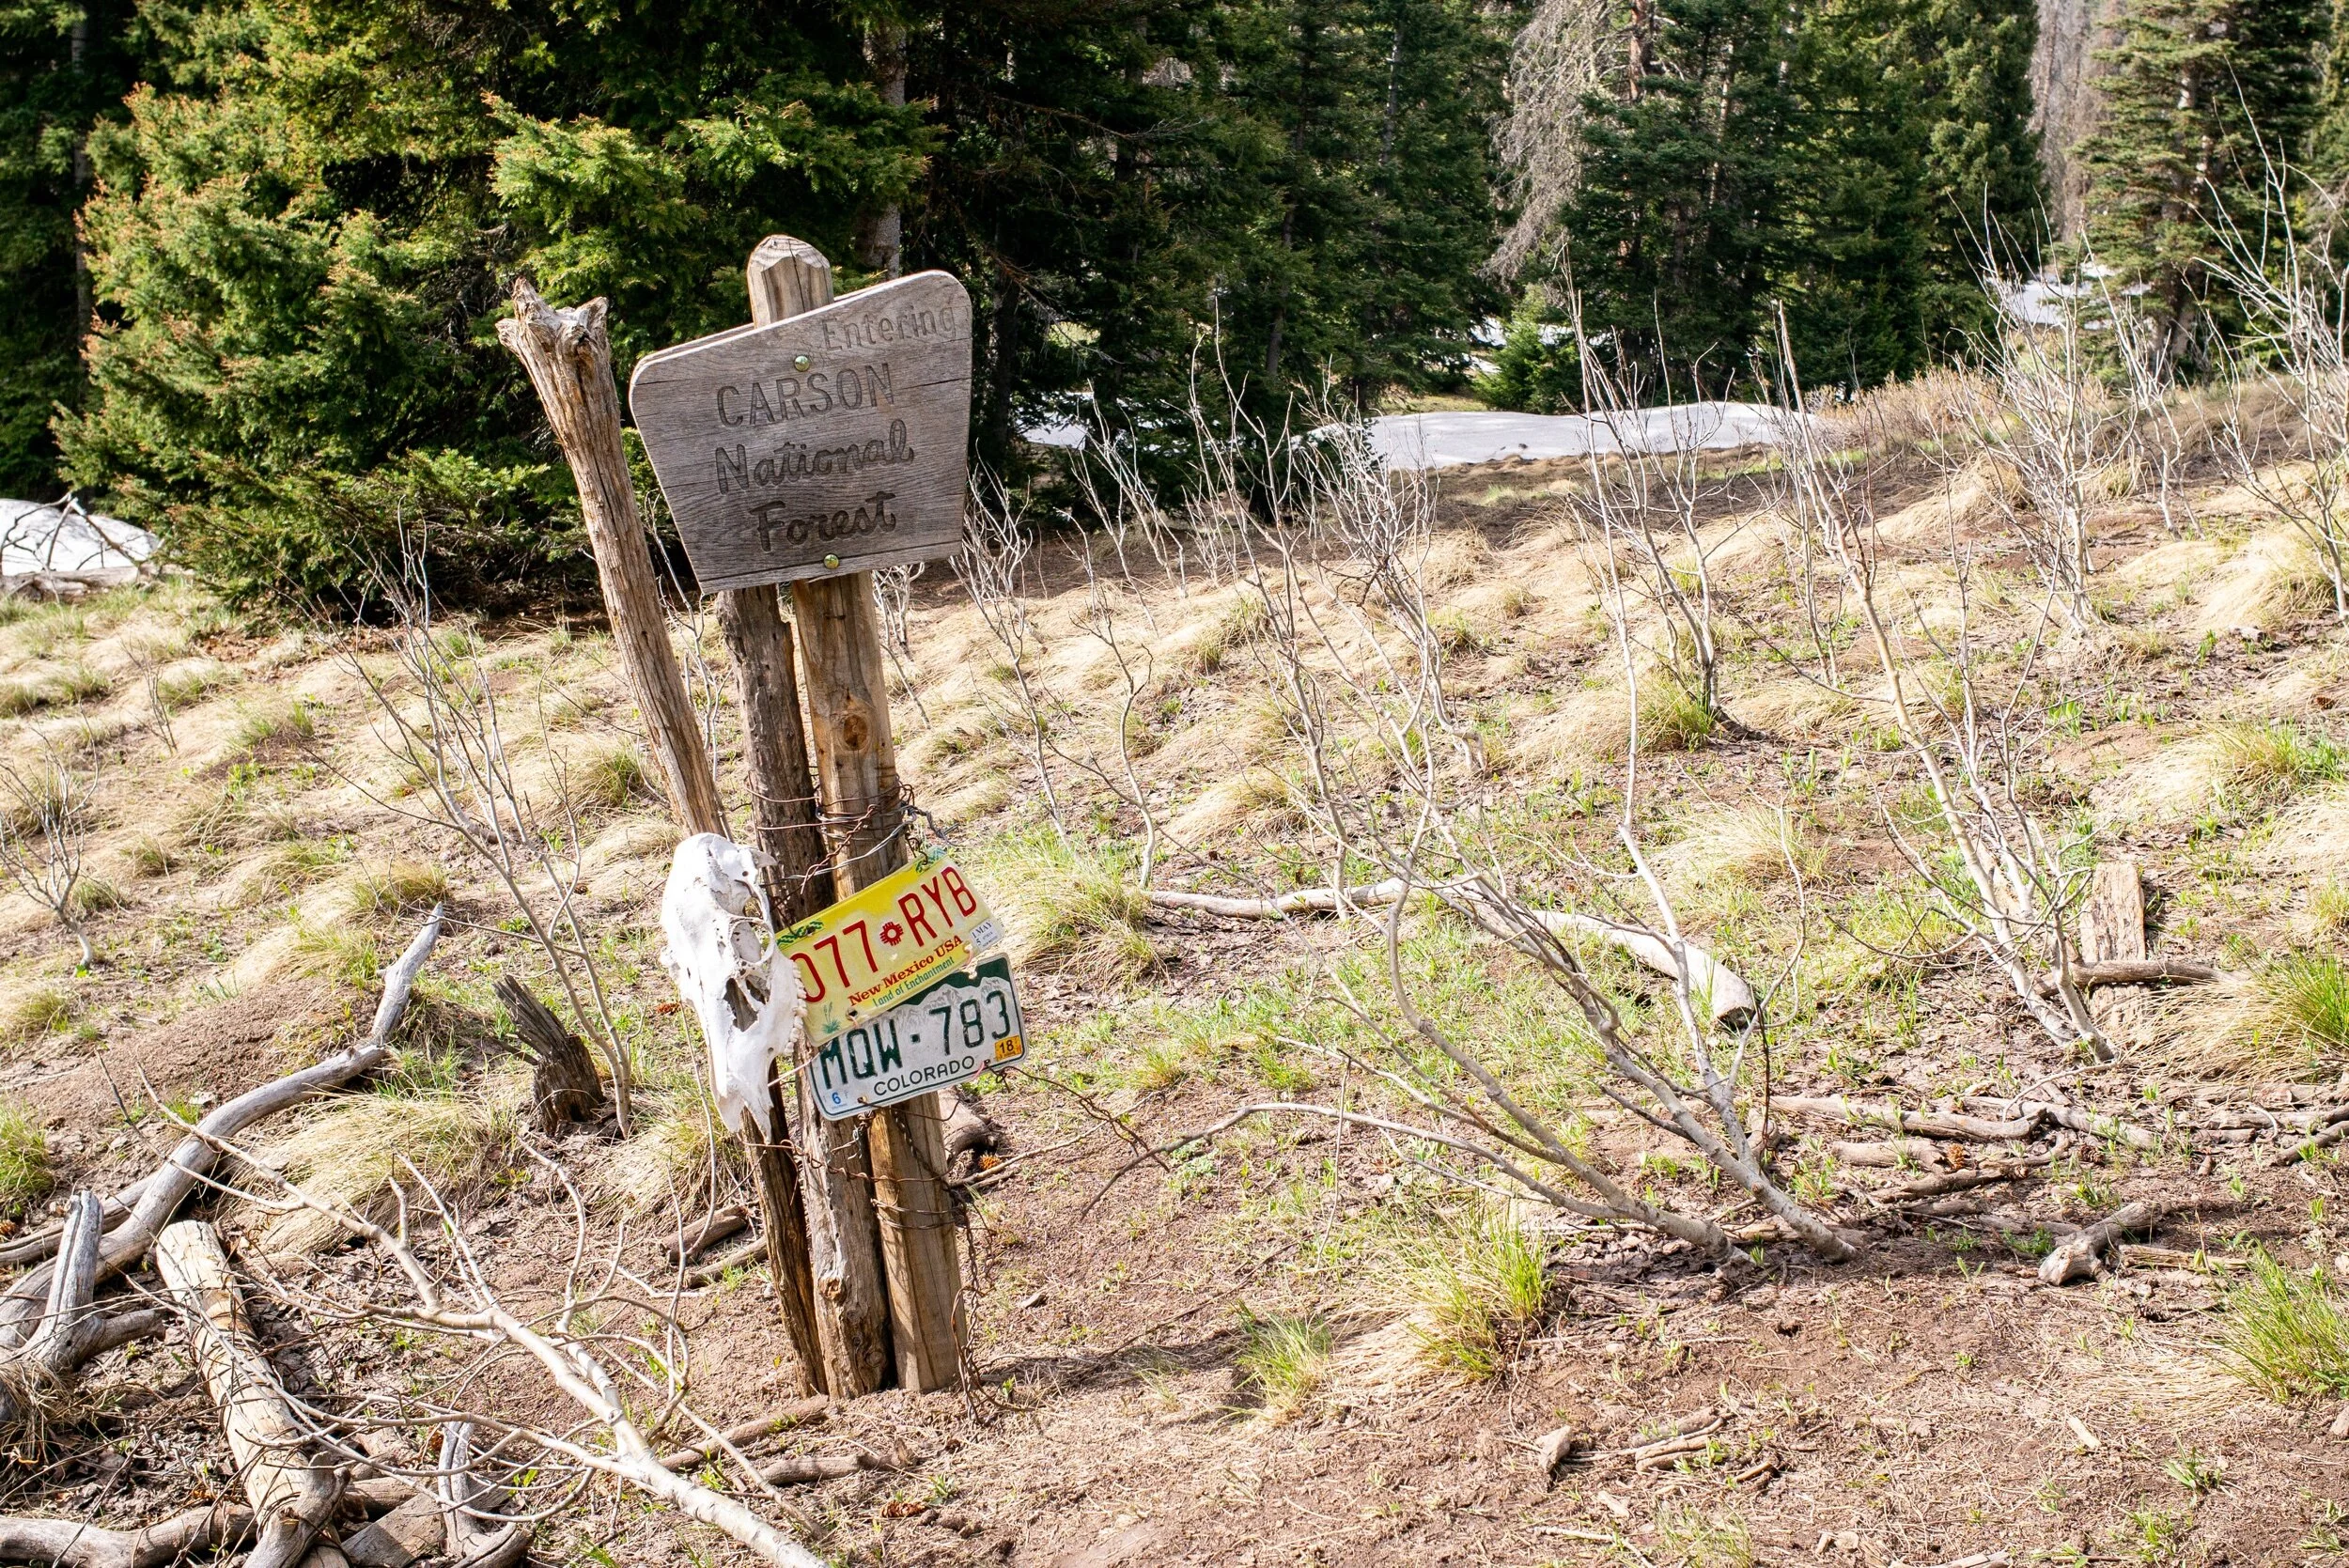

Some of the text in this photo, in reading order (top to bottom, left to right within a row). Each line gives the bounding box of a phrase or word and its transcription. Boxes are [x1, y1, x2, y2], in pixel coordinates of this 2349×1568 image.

[821, 305, 957, 351] Entering
[717, 362, 894, 427] CARSON
[715, 419, 914, 495] National
[749, 490, 896, 552] Forest
[848, 984, 883, 1006] New
[881, 955, 934, 988] Mexico
[934, 935, 963, 958] USA
[872, 956, 955, 1007] Land of Enchantment
[999, 1039, 1014, 1054] 18
[832, 1092, 842, 1105] 6
[873, 1055, 975, 1095] COLORADO
